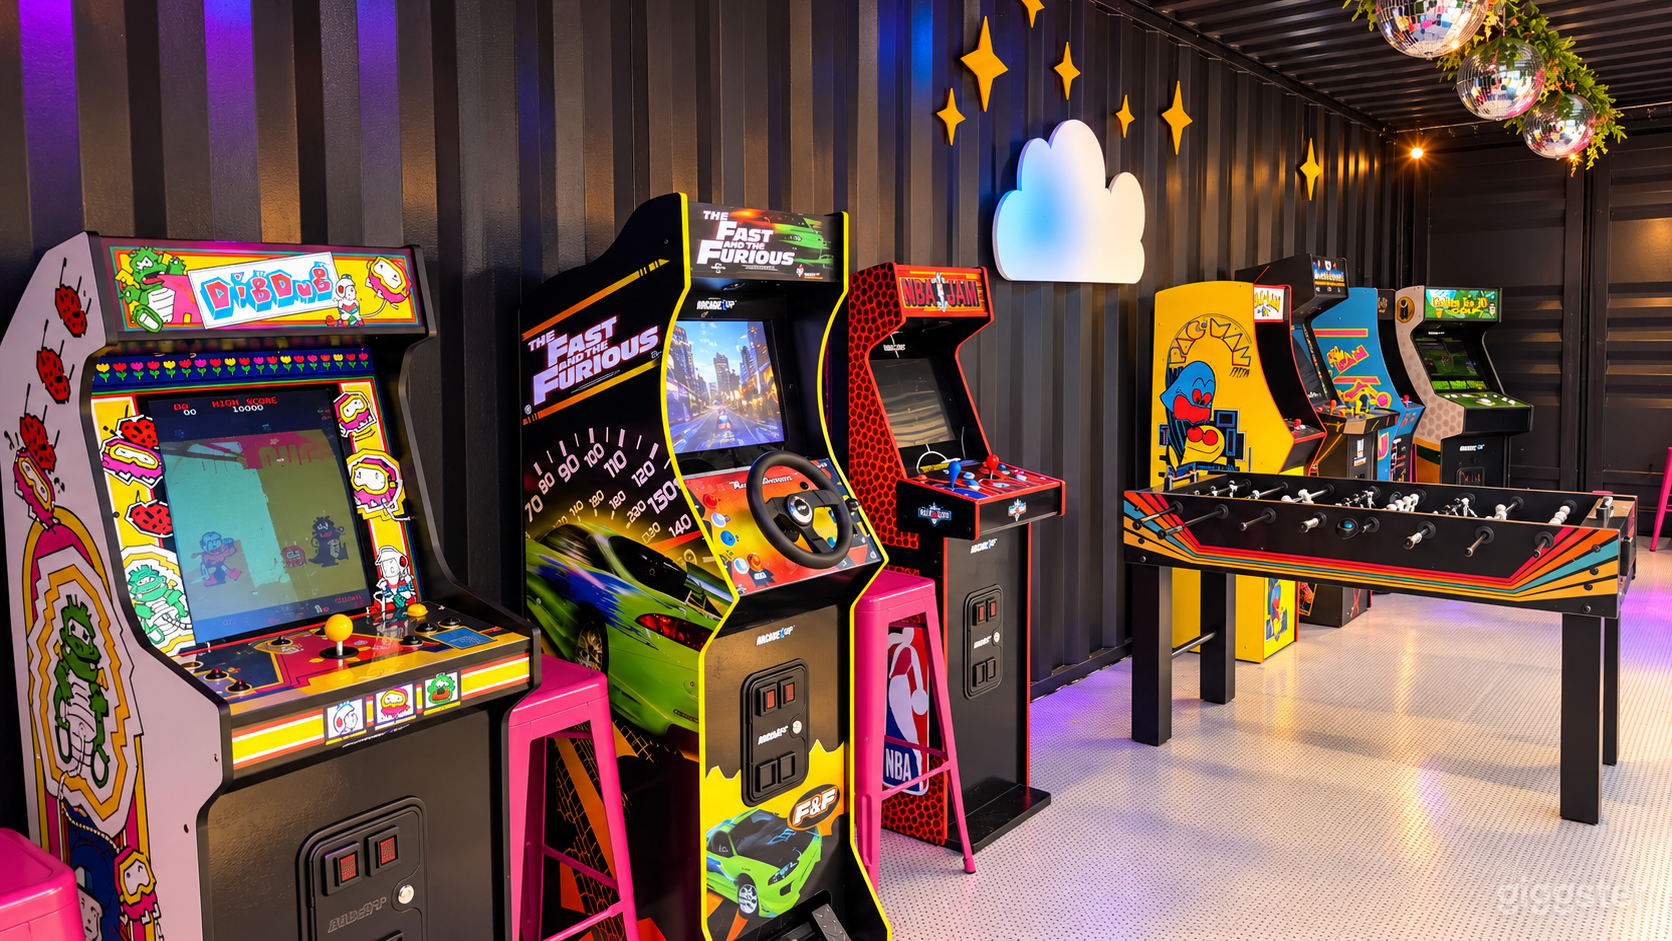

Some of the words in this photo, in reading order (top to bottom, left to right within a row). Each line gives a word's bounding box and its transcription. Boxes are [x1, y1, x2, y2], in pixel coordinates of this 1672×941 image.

[703, 210, 729, 221] THE
[716, 221, 774, 242] FAST
[696, 239, 795, 265] FURIOUS
[723, 241, 745, 249] AND
[746, 242, 765, 250] THE
[901, 278, 935, 307] NBA
[946, 279, 980, 307] JAM
[528, 330, 555, 351] THE
[548, 315, 618, 367] FAST
[532, 325, 659, 406] FURIOUS
[558, 353, 583, 371] AND
[583, 340, 608, 357] THE
[233, 404, 264, 413] 10000
[558, 454, 580, 483] 90
[584, 443, 605, 468] 100
[604, 450, 627, 478] 110
[538, 471, 555, 495] 80
[631, 460, 656, 487] 120
[525, 495, 543, 522] 70
[668, 514, 692, 538] 140
[885, 748, 912, 782] NBA
[794, 788, 836, 824] F&F
